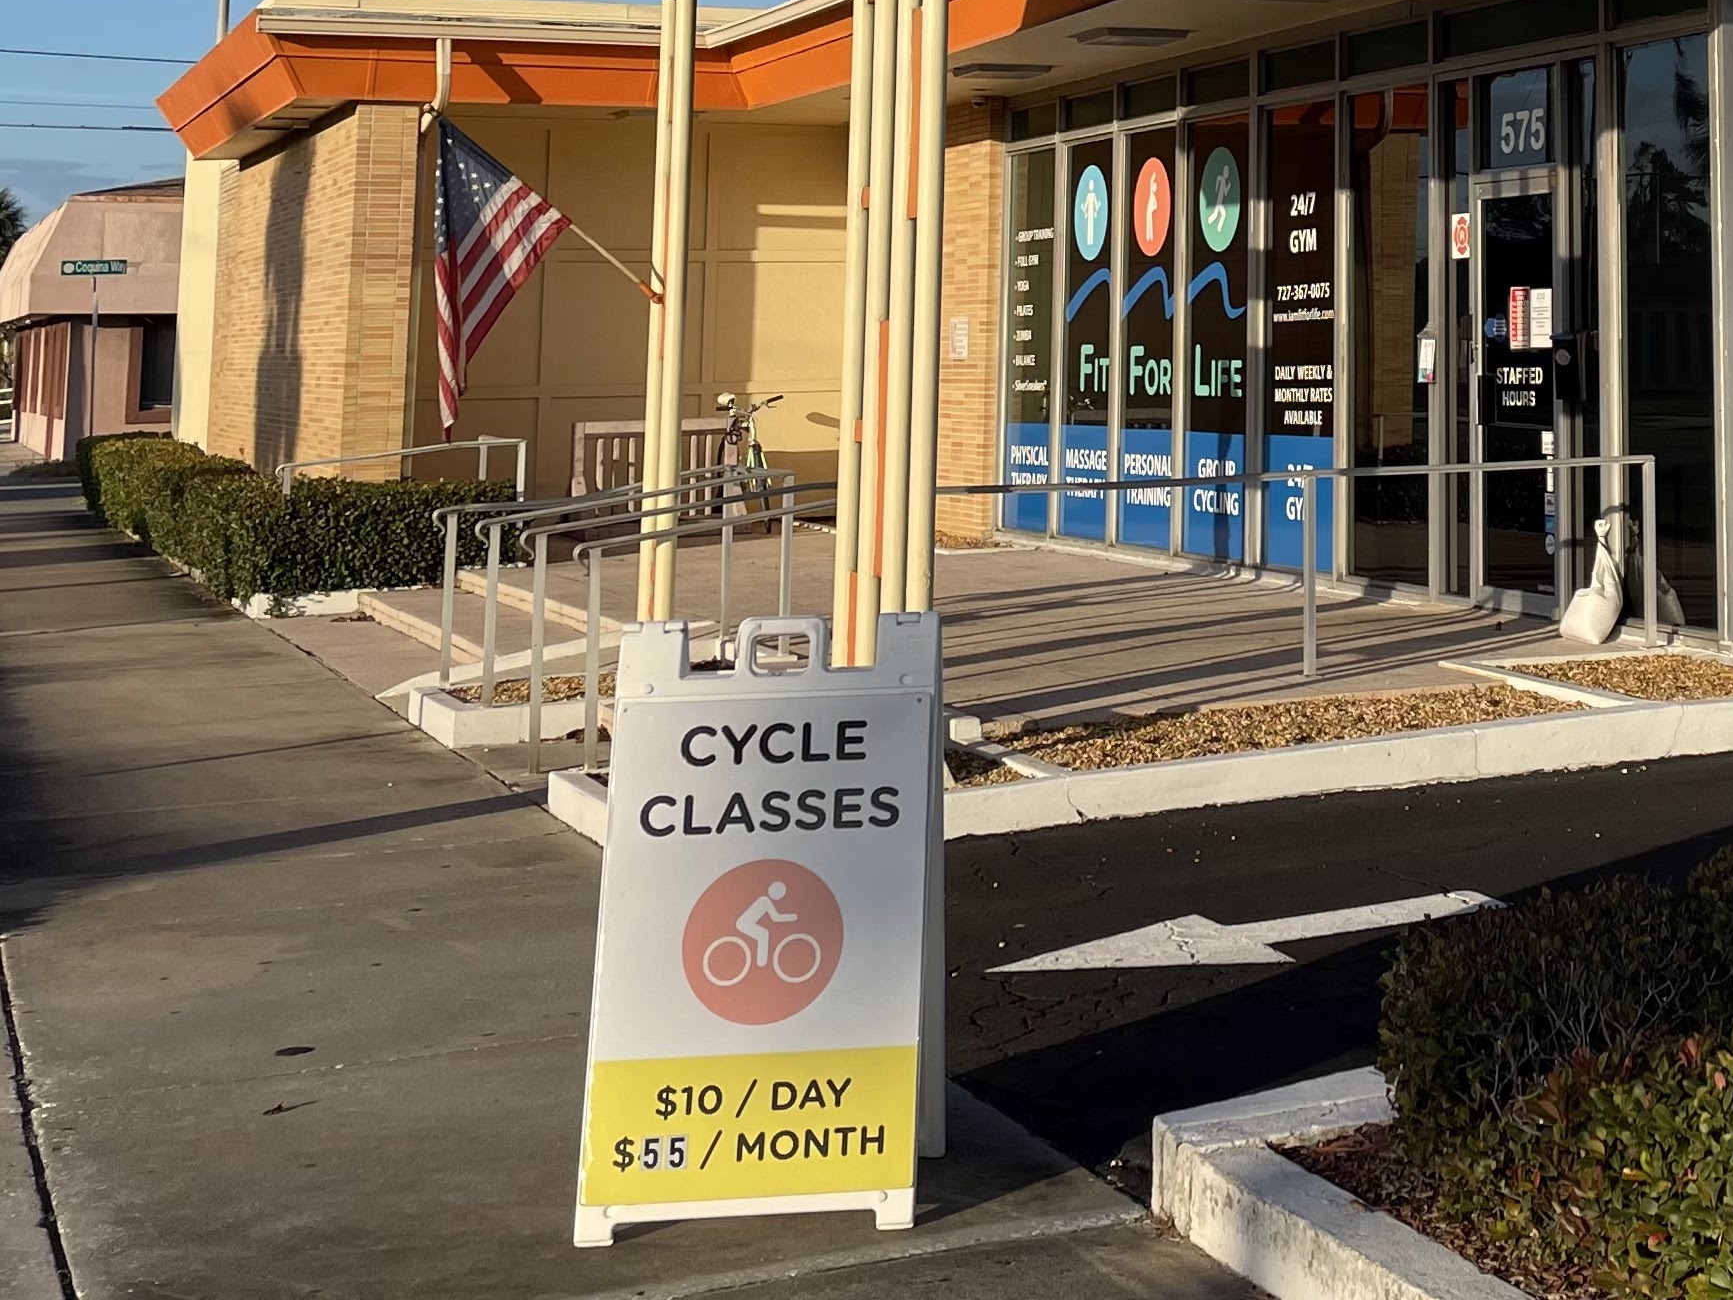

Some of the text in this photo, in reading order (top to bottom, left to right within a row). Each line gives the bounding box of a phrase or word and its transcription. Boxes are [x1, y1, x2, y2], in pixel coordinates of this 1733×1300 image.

[1501, 108, 1545, 154] 575
[1290, 192, 1316, 216] 24/7
[1290, 228, 1317, 253] GYM
[76, 261, 126, 274] Coquina Way
[1277, 282, 1330, 301] 727-367-0075
[1080, 344, 1243, 397] FIT FOR LIFE
[1275, 365, 1295, 380] DAILY
[1297, 364, 1326, 380] WEEKLY
[1496, 367, 1543, 385] STAFFED
[1275, 387, 1333, 402] MONTHLY RATES
[1502, 391, 1536, 407] HOURS
[1283, 410, 1322, 425] AVAILABLE
[1010, 445, 1049, 467] PHYSICAL
[1066, 449, 1107, 471] MASSAGE
[1124, 454, 1172, 477] PERSONAL
[1193, 488, 1239, 516] CYCLING
[1286, 496, 1304, 521] GY
[680, 719, 868, 767] CYCLE
[639, 786, 901, 838] CLASSES
[655, 1077, 852, 1120] $10 / DAY
[612, 1126, 886, 1174] $55 / MONTH
